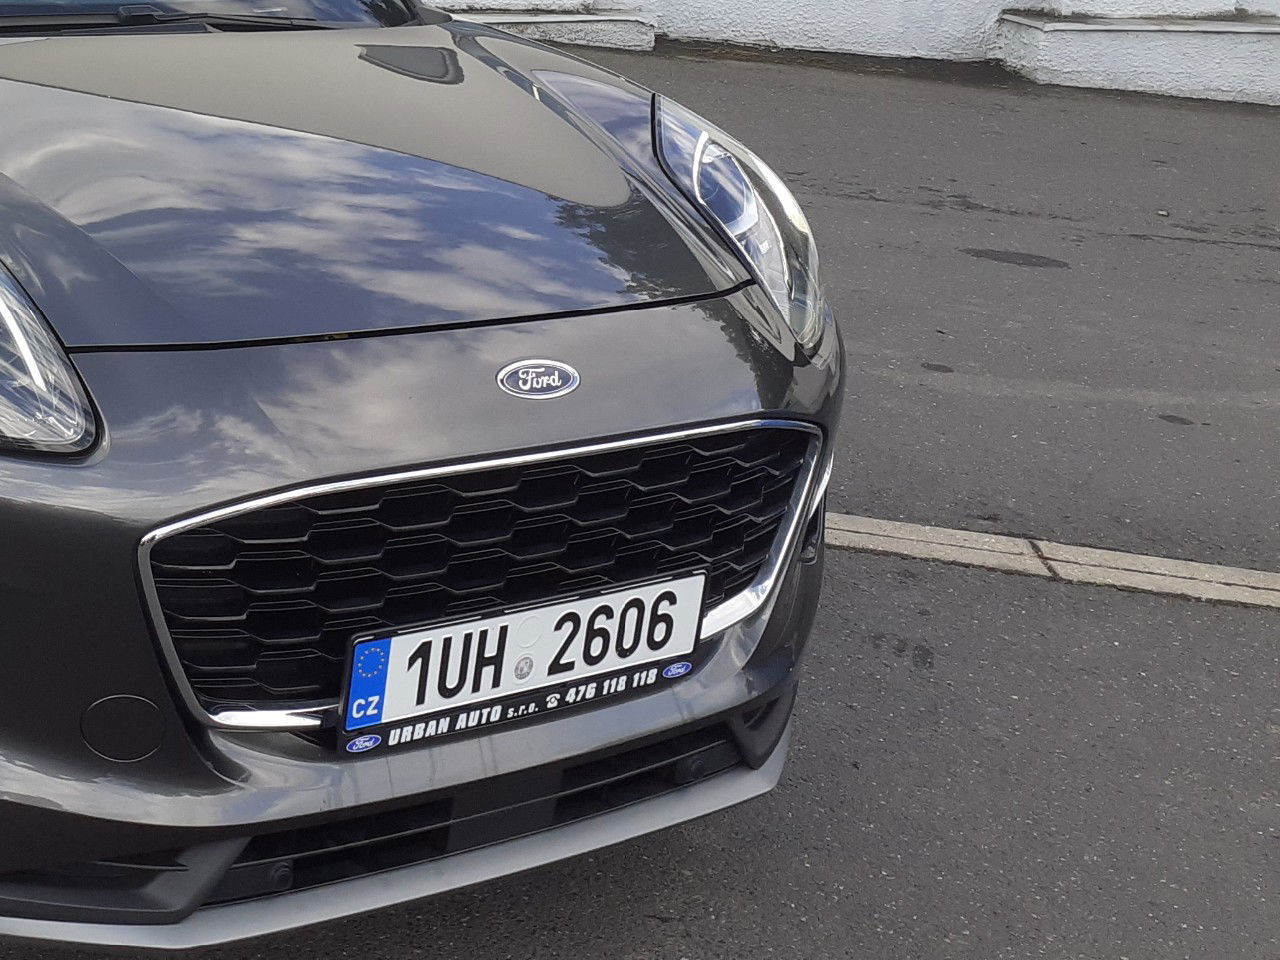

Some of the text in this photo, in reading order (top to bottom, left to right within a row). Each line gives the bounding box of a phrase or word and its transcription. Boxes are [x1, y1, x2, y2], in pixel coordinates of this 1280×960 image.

[518, 367, 562, 391] Ford
[406, 590, 677, 706] 1UH 2606
[667, 664, 689, 676] Ford
[351, 695, 380, 719] CZ
[388, 716, 450, 746] URBAN
[455, 705, 502, 730] AUTO
[507, 702, 539, 718] s.r.o.
[565, 682, 597, 704] 476
[352, 737, 376, 751] Ford
